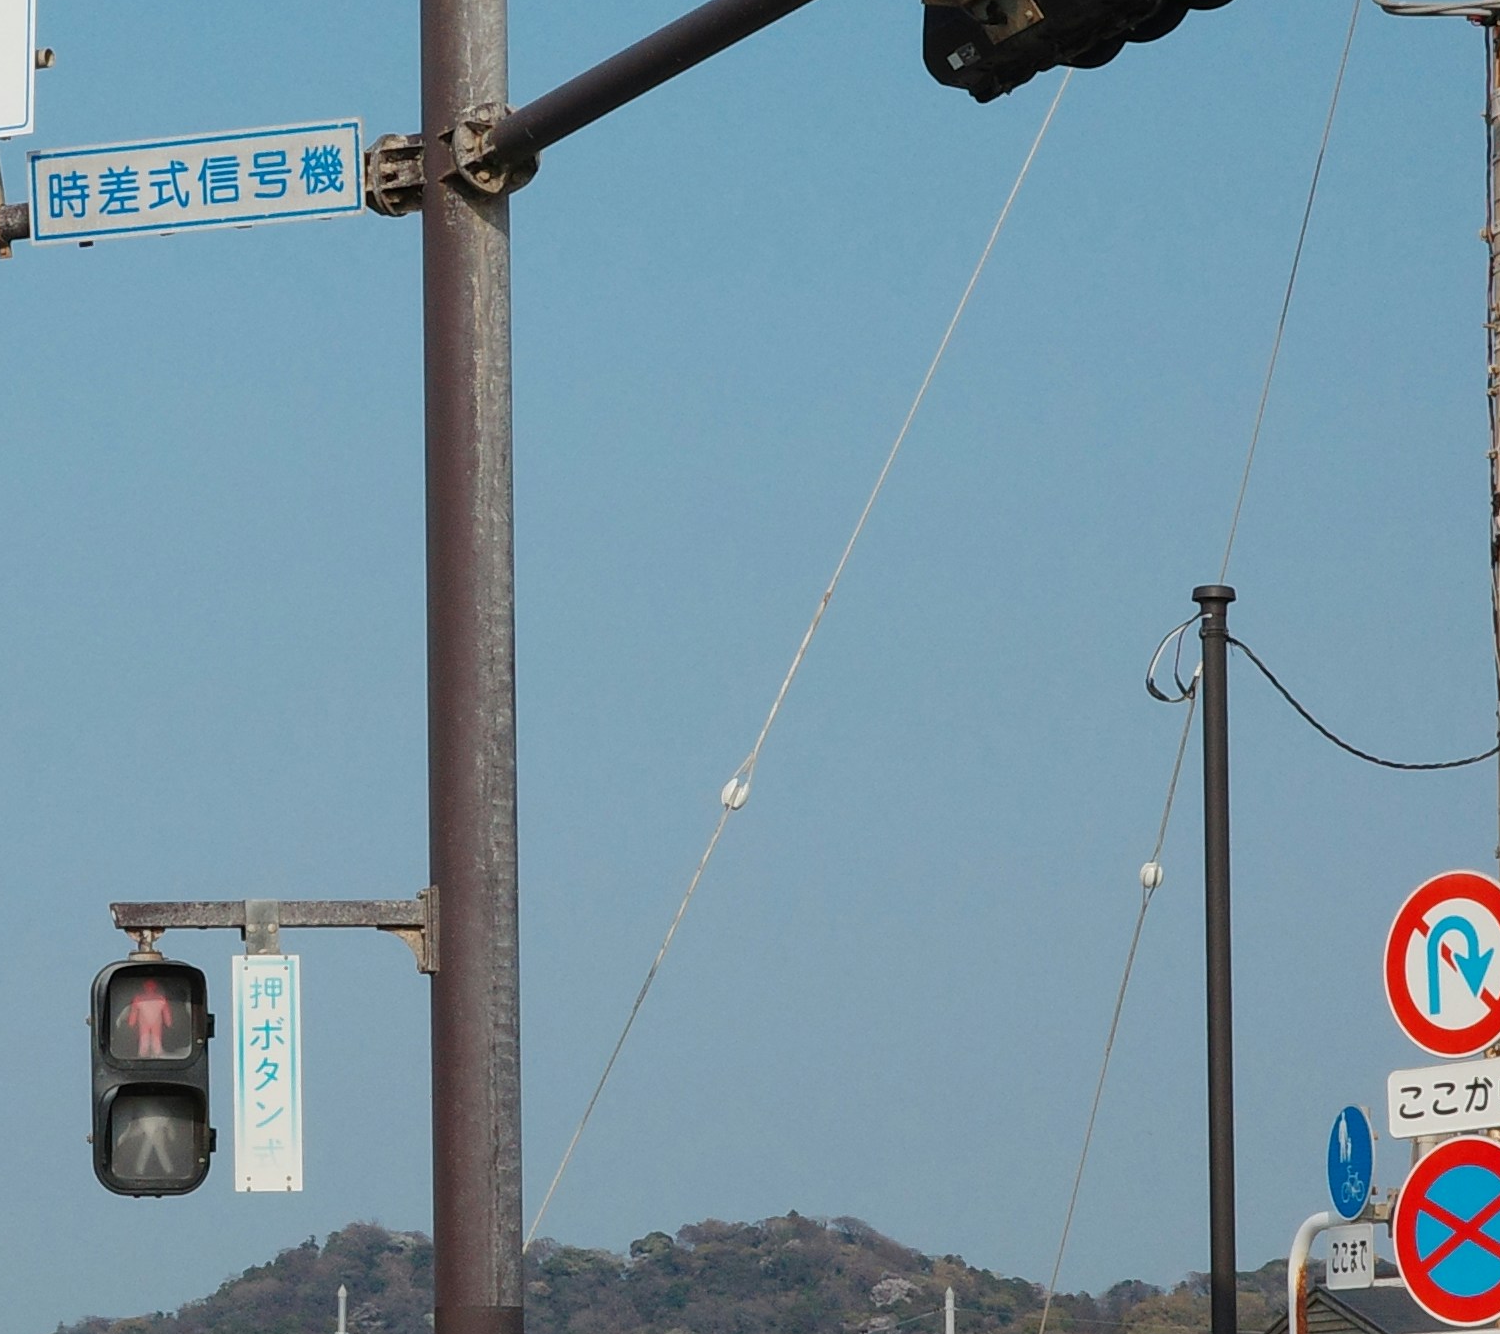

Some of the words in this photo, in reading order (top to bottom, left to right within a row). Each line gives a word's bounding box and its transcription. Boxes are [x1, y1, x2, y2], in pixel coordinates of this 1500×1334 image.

[48, 144, 345, 219] 時差式信号機
[1331, 1239, 1369, 1274] ここまで
